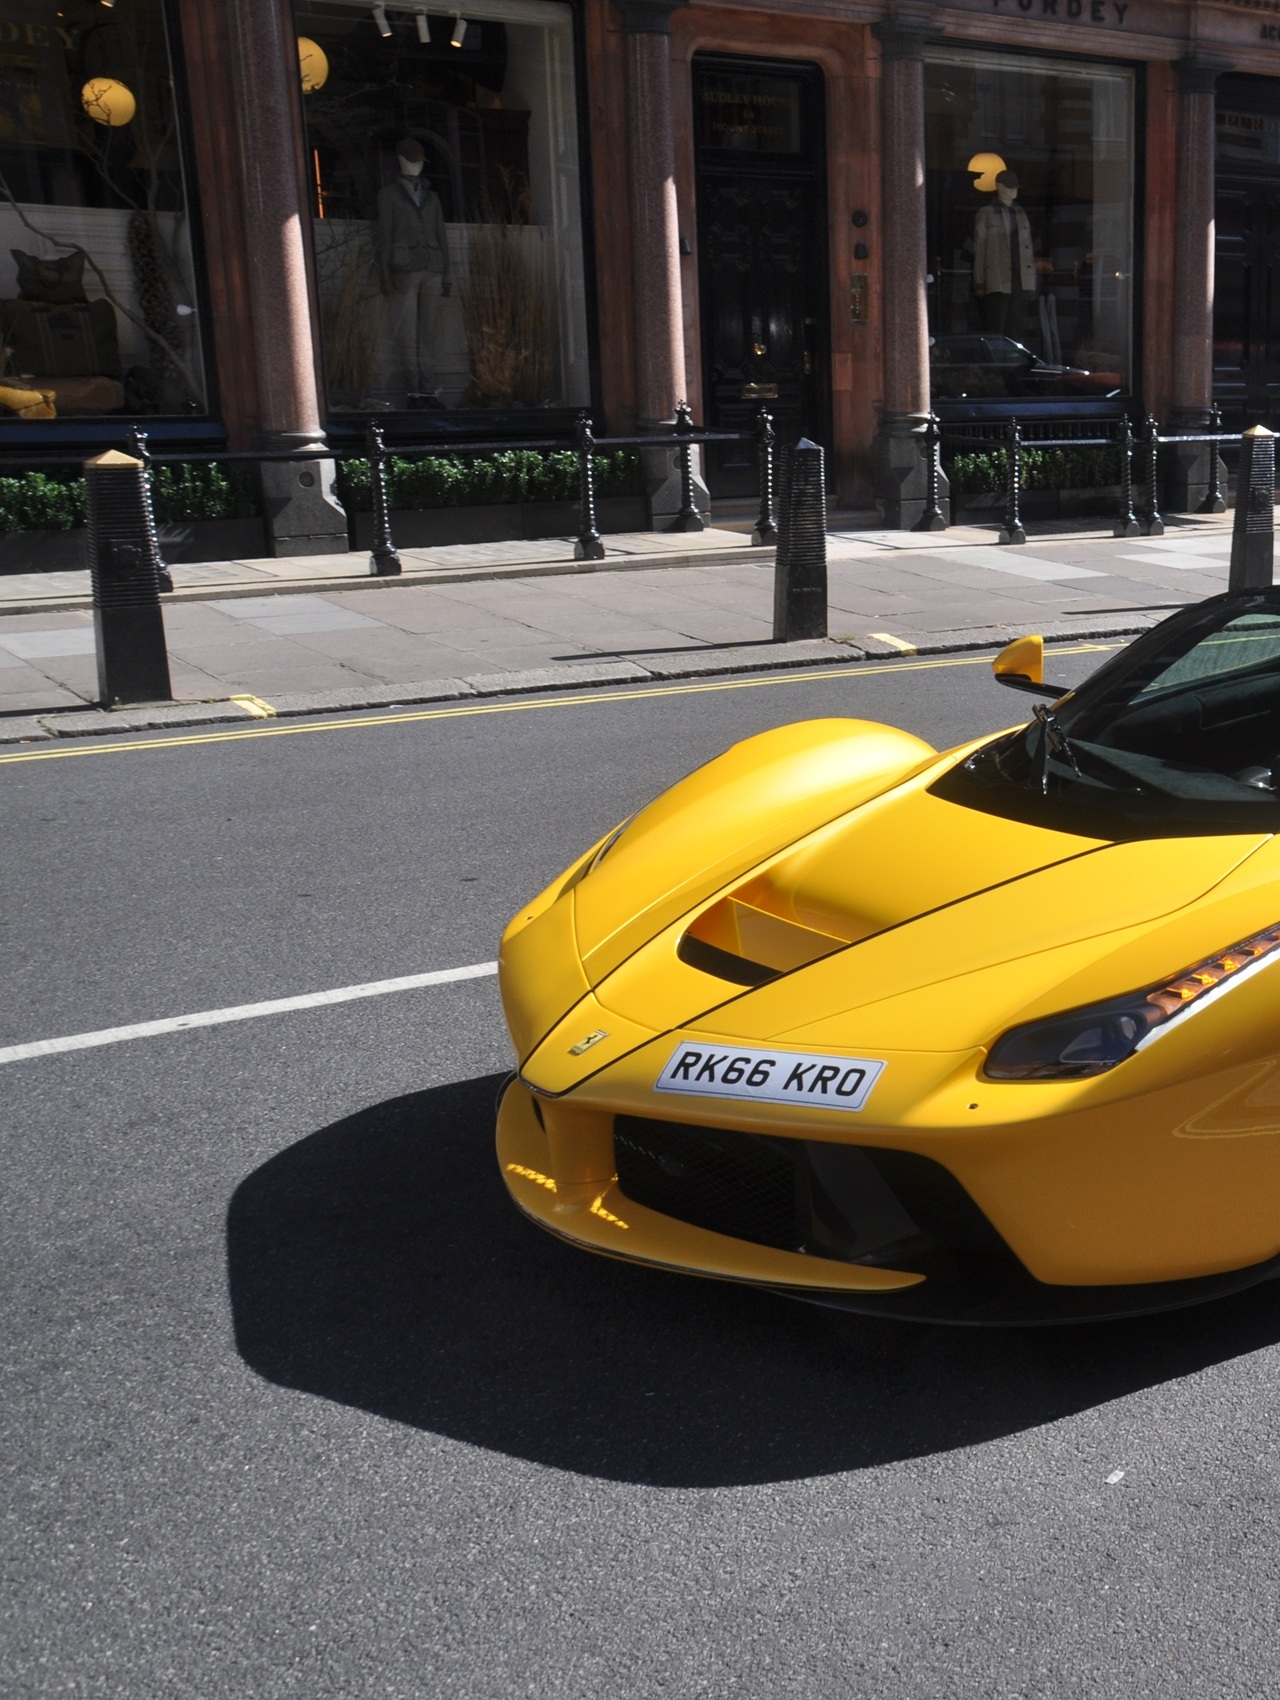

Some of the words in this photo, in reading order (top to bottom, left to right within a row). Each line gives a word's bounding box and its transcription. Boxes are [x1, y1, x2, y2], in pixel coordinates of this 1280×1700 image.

[702, 91, 751, 104] AUDLEY
[712, 120, 749, 133] MOUNT
[669, 1051, 777, 1087] RK66
[782, 1062, 867, 1097] KRO
